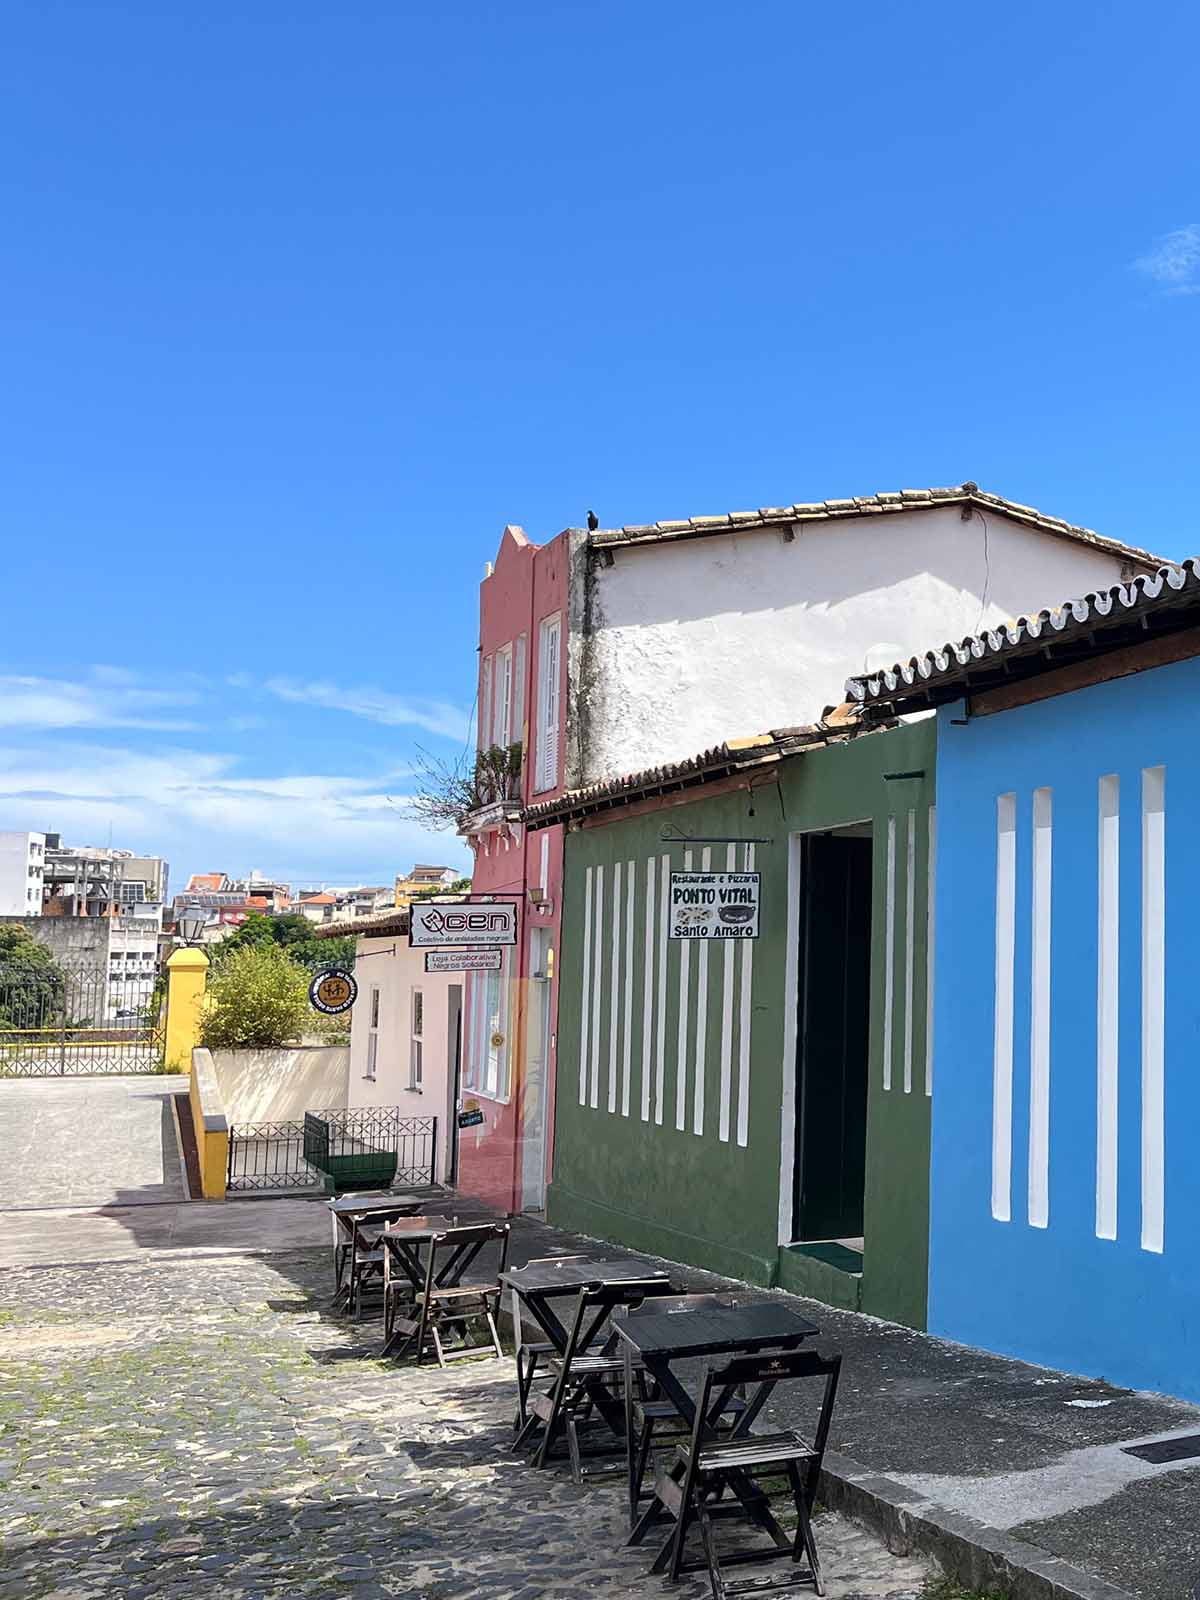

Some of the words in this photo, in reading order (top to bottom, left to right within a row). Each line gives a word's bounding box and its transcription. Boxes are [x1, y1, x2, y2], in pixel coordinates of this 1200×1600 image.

[673, 888, 716, 904] PONTO
[719, 888, 757, 903] VITAL
[674, 926, 708, 937] Santo
[714, 926, 753, 937] Amaro
